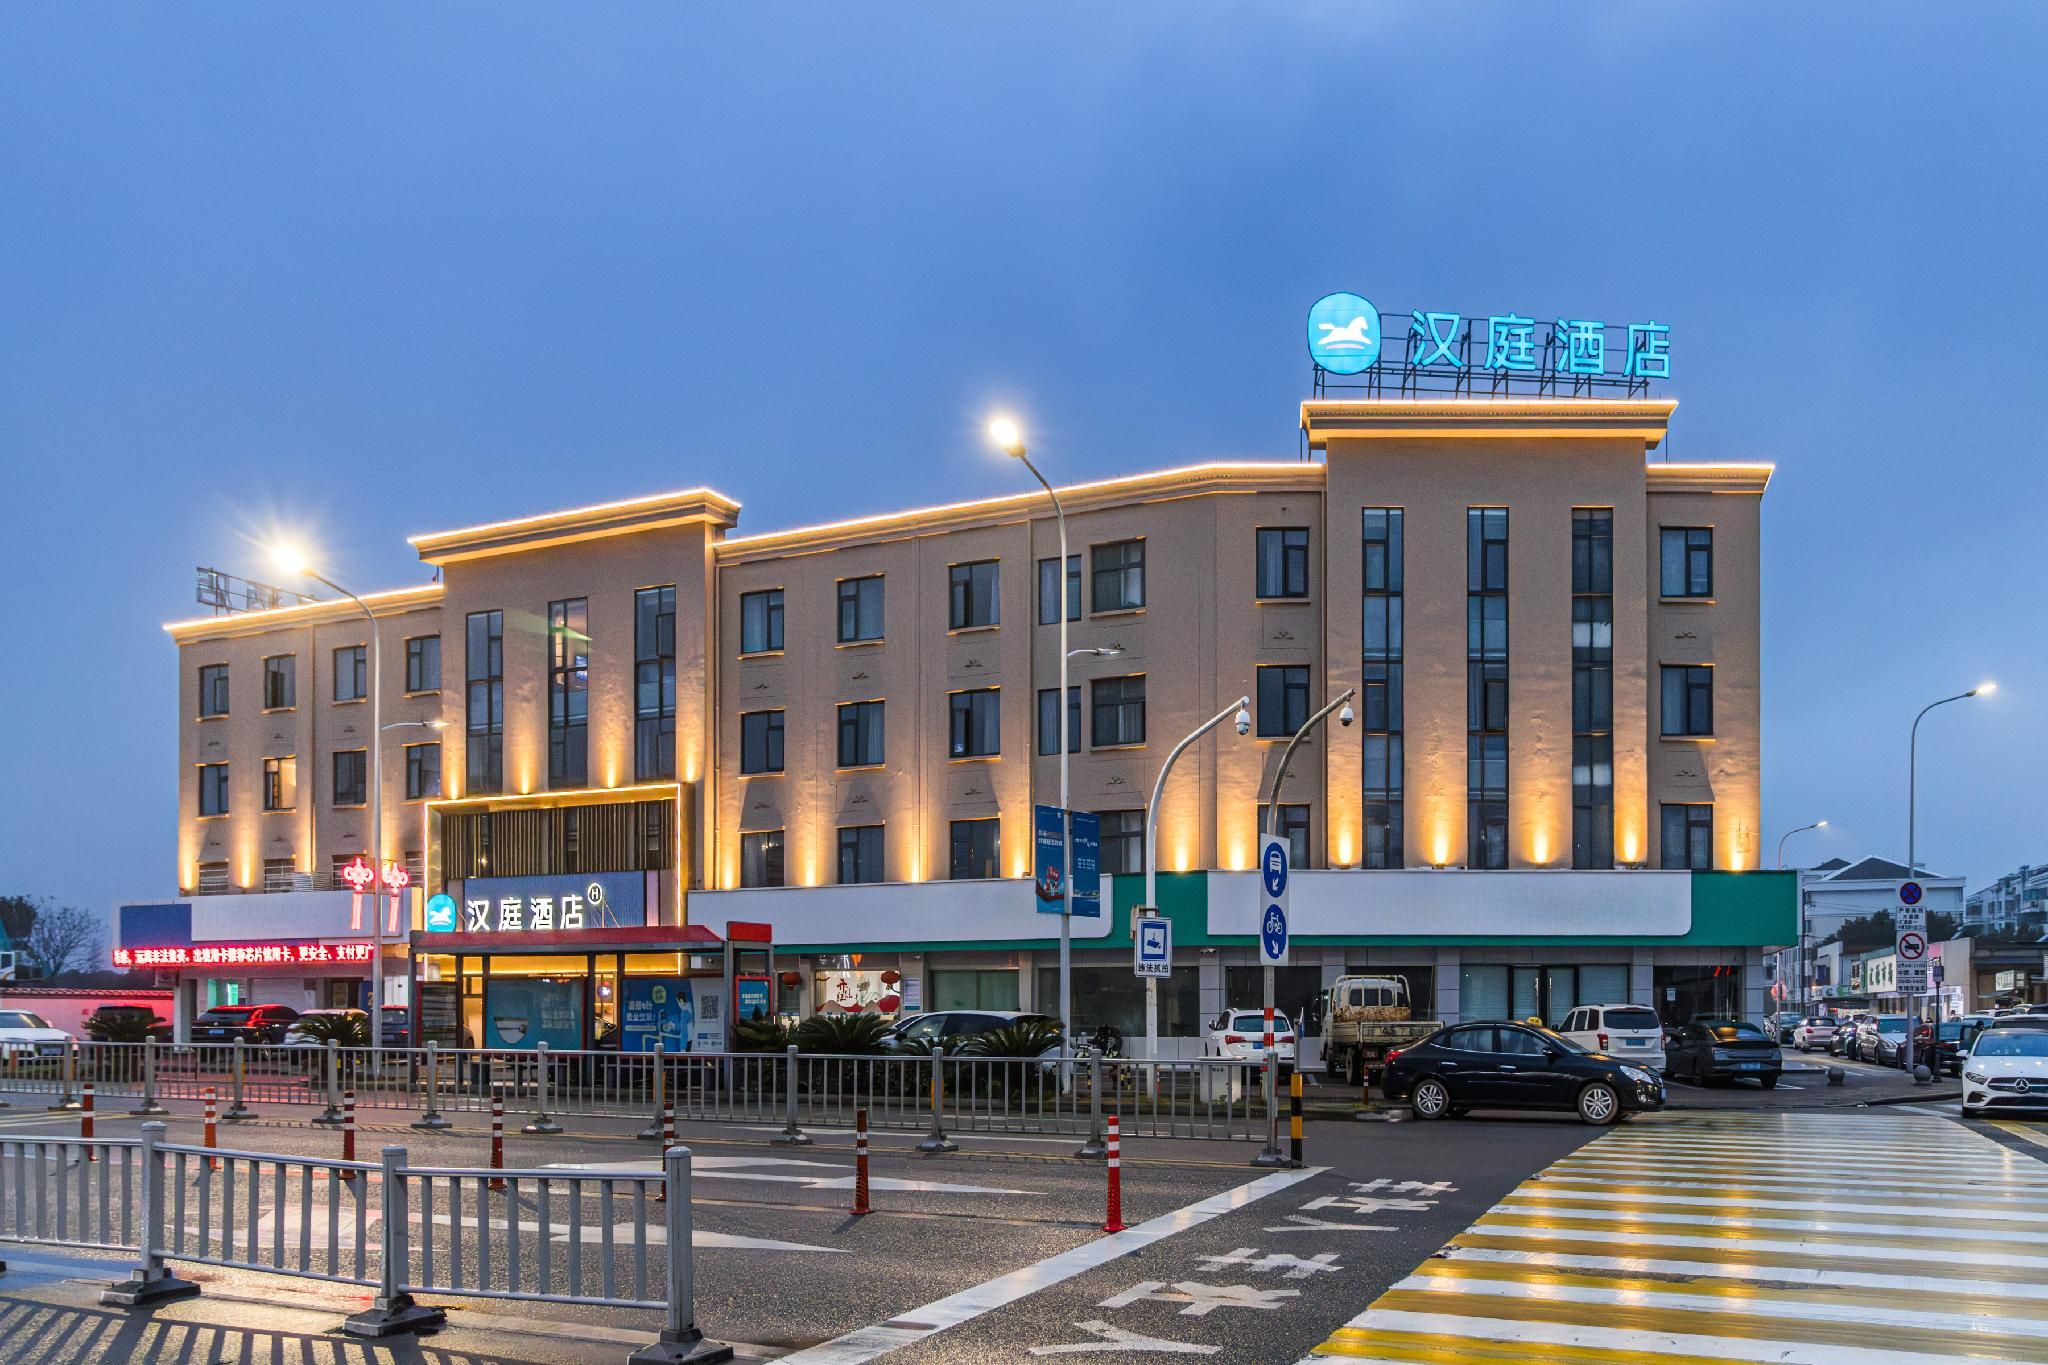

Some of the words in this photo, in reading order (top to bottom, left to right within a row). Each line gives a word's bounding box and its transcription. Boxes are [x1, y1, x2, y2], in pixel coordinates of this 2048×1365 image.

[1411, 308, 1672, 380] 汉庭酒店
[467, 894, 584, 931] 汉庭酒店
[1137, 963, 1169, 973] 违法抓拍
